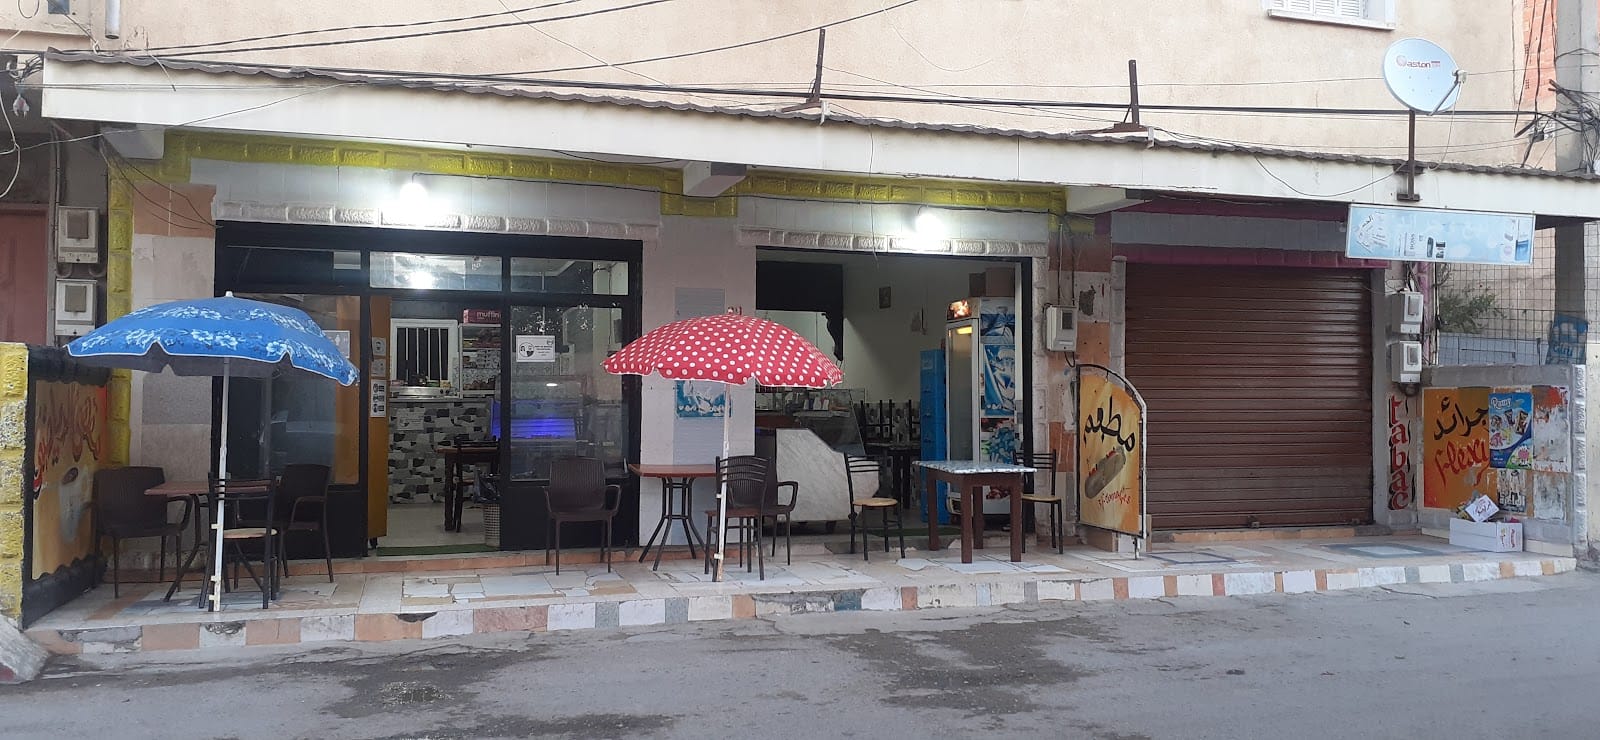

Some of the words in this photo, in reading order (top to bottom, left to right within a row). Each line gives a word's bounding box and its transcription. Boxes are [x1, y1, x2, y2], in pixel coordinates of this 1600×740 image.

[1407, 60, 1431, 69] aston
[1083, 396, 1137, 452] مطعم
[1388, 394, 1409, 511] tabac
